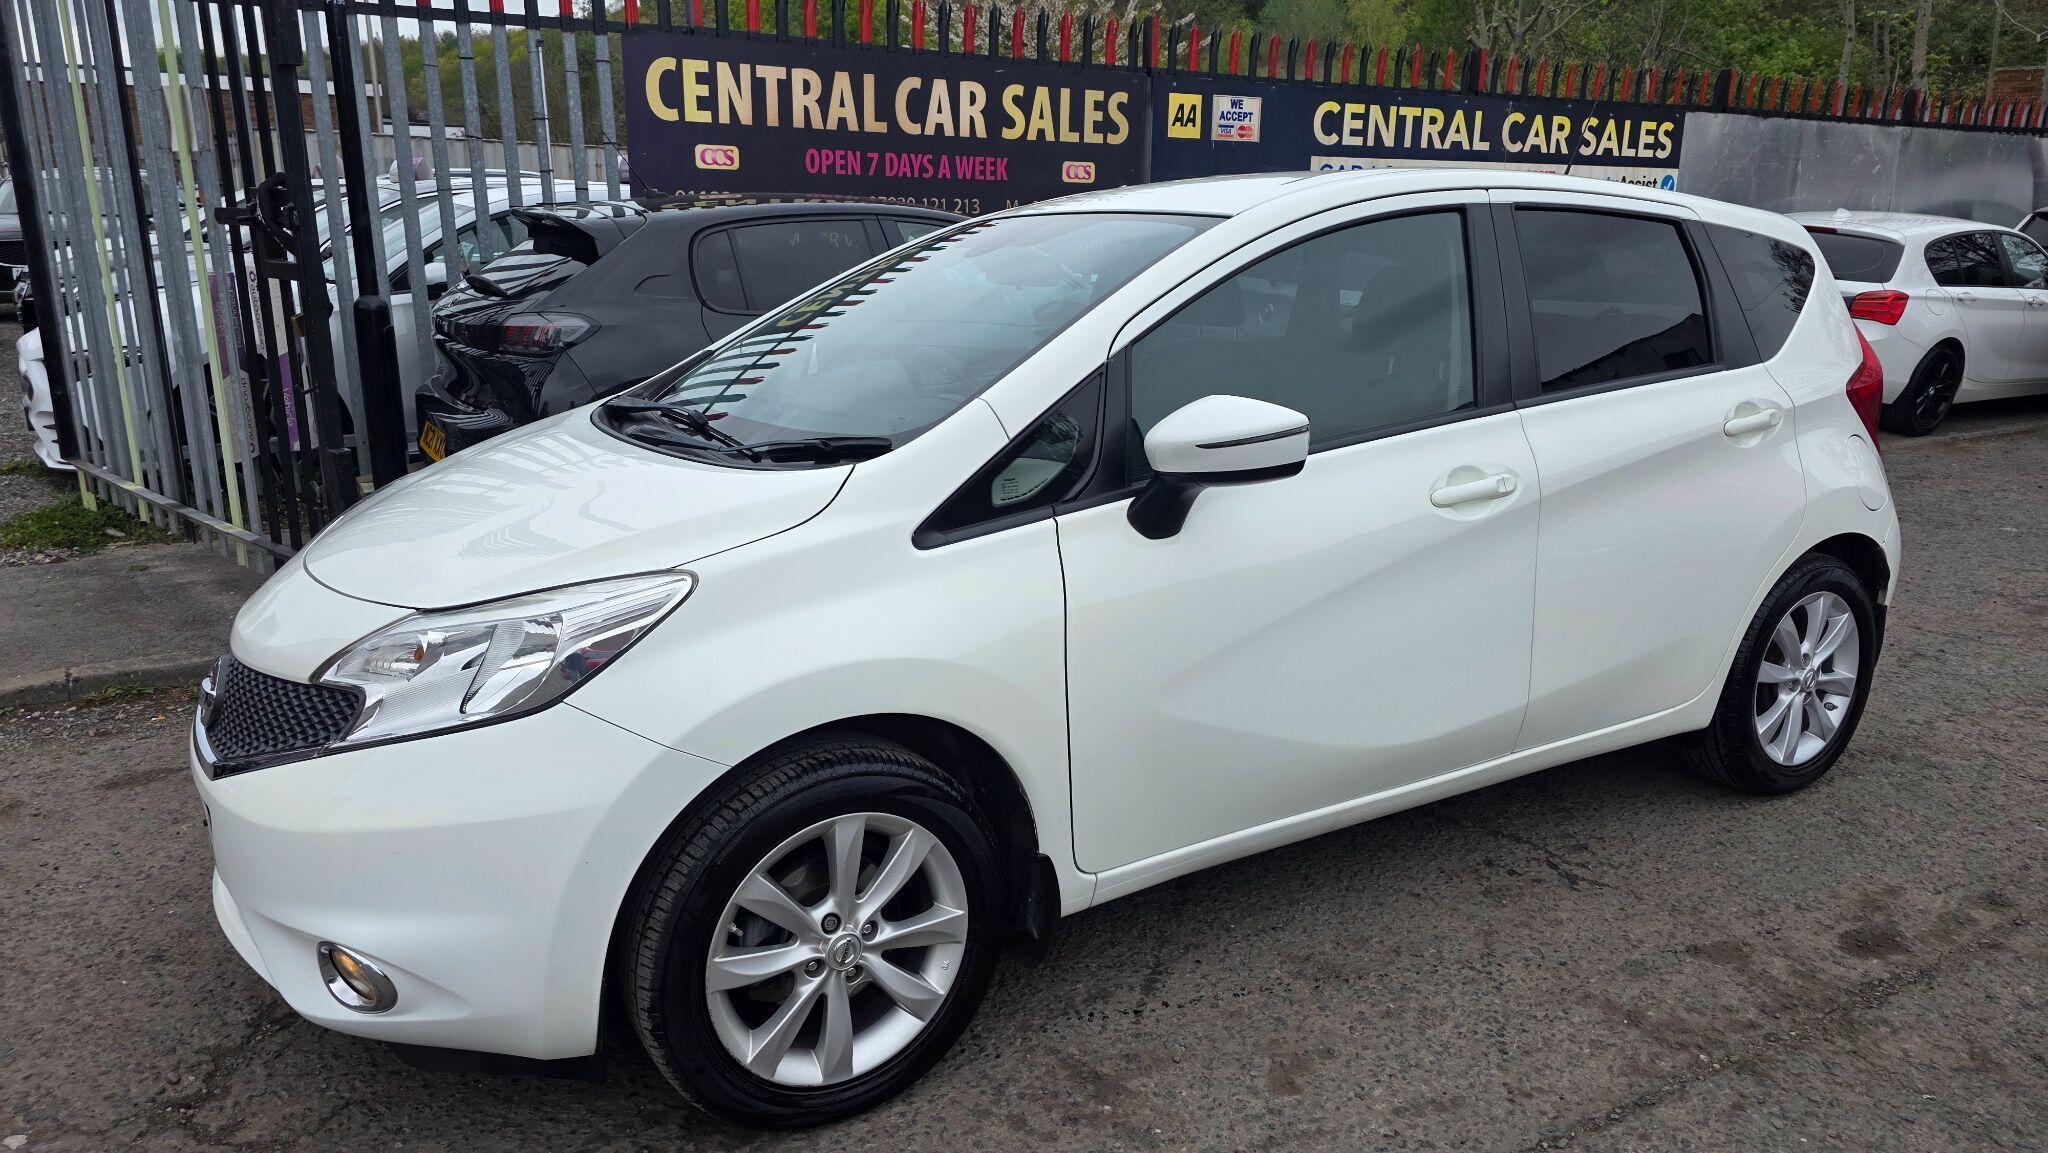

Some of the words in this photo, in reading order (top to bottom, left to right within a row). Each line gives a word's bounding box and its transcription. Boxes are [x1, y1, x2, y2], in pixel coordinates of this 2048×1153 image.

[645, 56, 887, 133] CENTRAL
[895, 76, 987, 139] CAR
[1001, 84, 1129, 145] SALES
[1230, 98, 1244, 110] WE
[1171, 103, 1197, 127] AA
[1219, 110, 1254, 123] ACCEPT
[1313, 101, 1490, 150] CENTRAL
[1502, 112, 1571, 155] CAR
[1578, 116, 1675, 159] SALES
[700, 148, 735, 166] CCS
[805, 148, 861, 176] OPEN
[866, 152, 879, 176] 7
[885, 152, 934, 178] DAYS
[937, 154, 951, 179] A
[955, 155, 1009, 181] WEEK
[1065, 164, 1092, 180] CCS
[953, 198, 980, 214] 213
[282, 387, 295, 427] Vehicle
